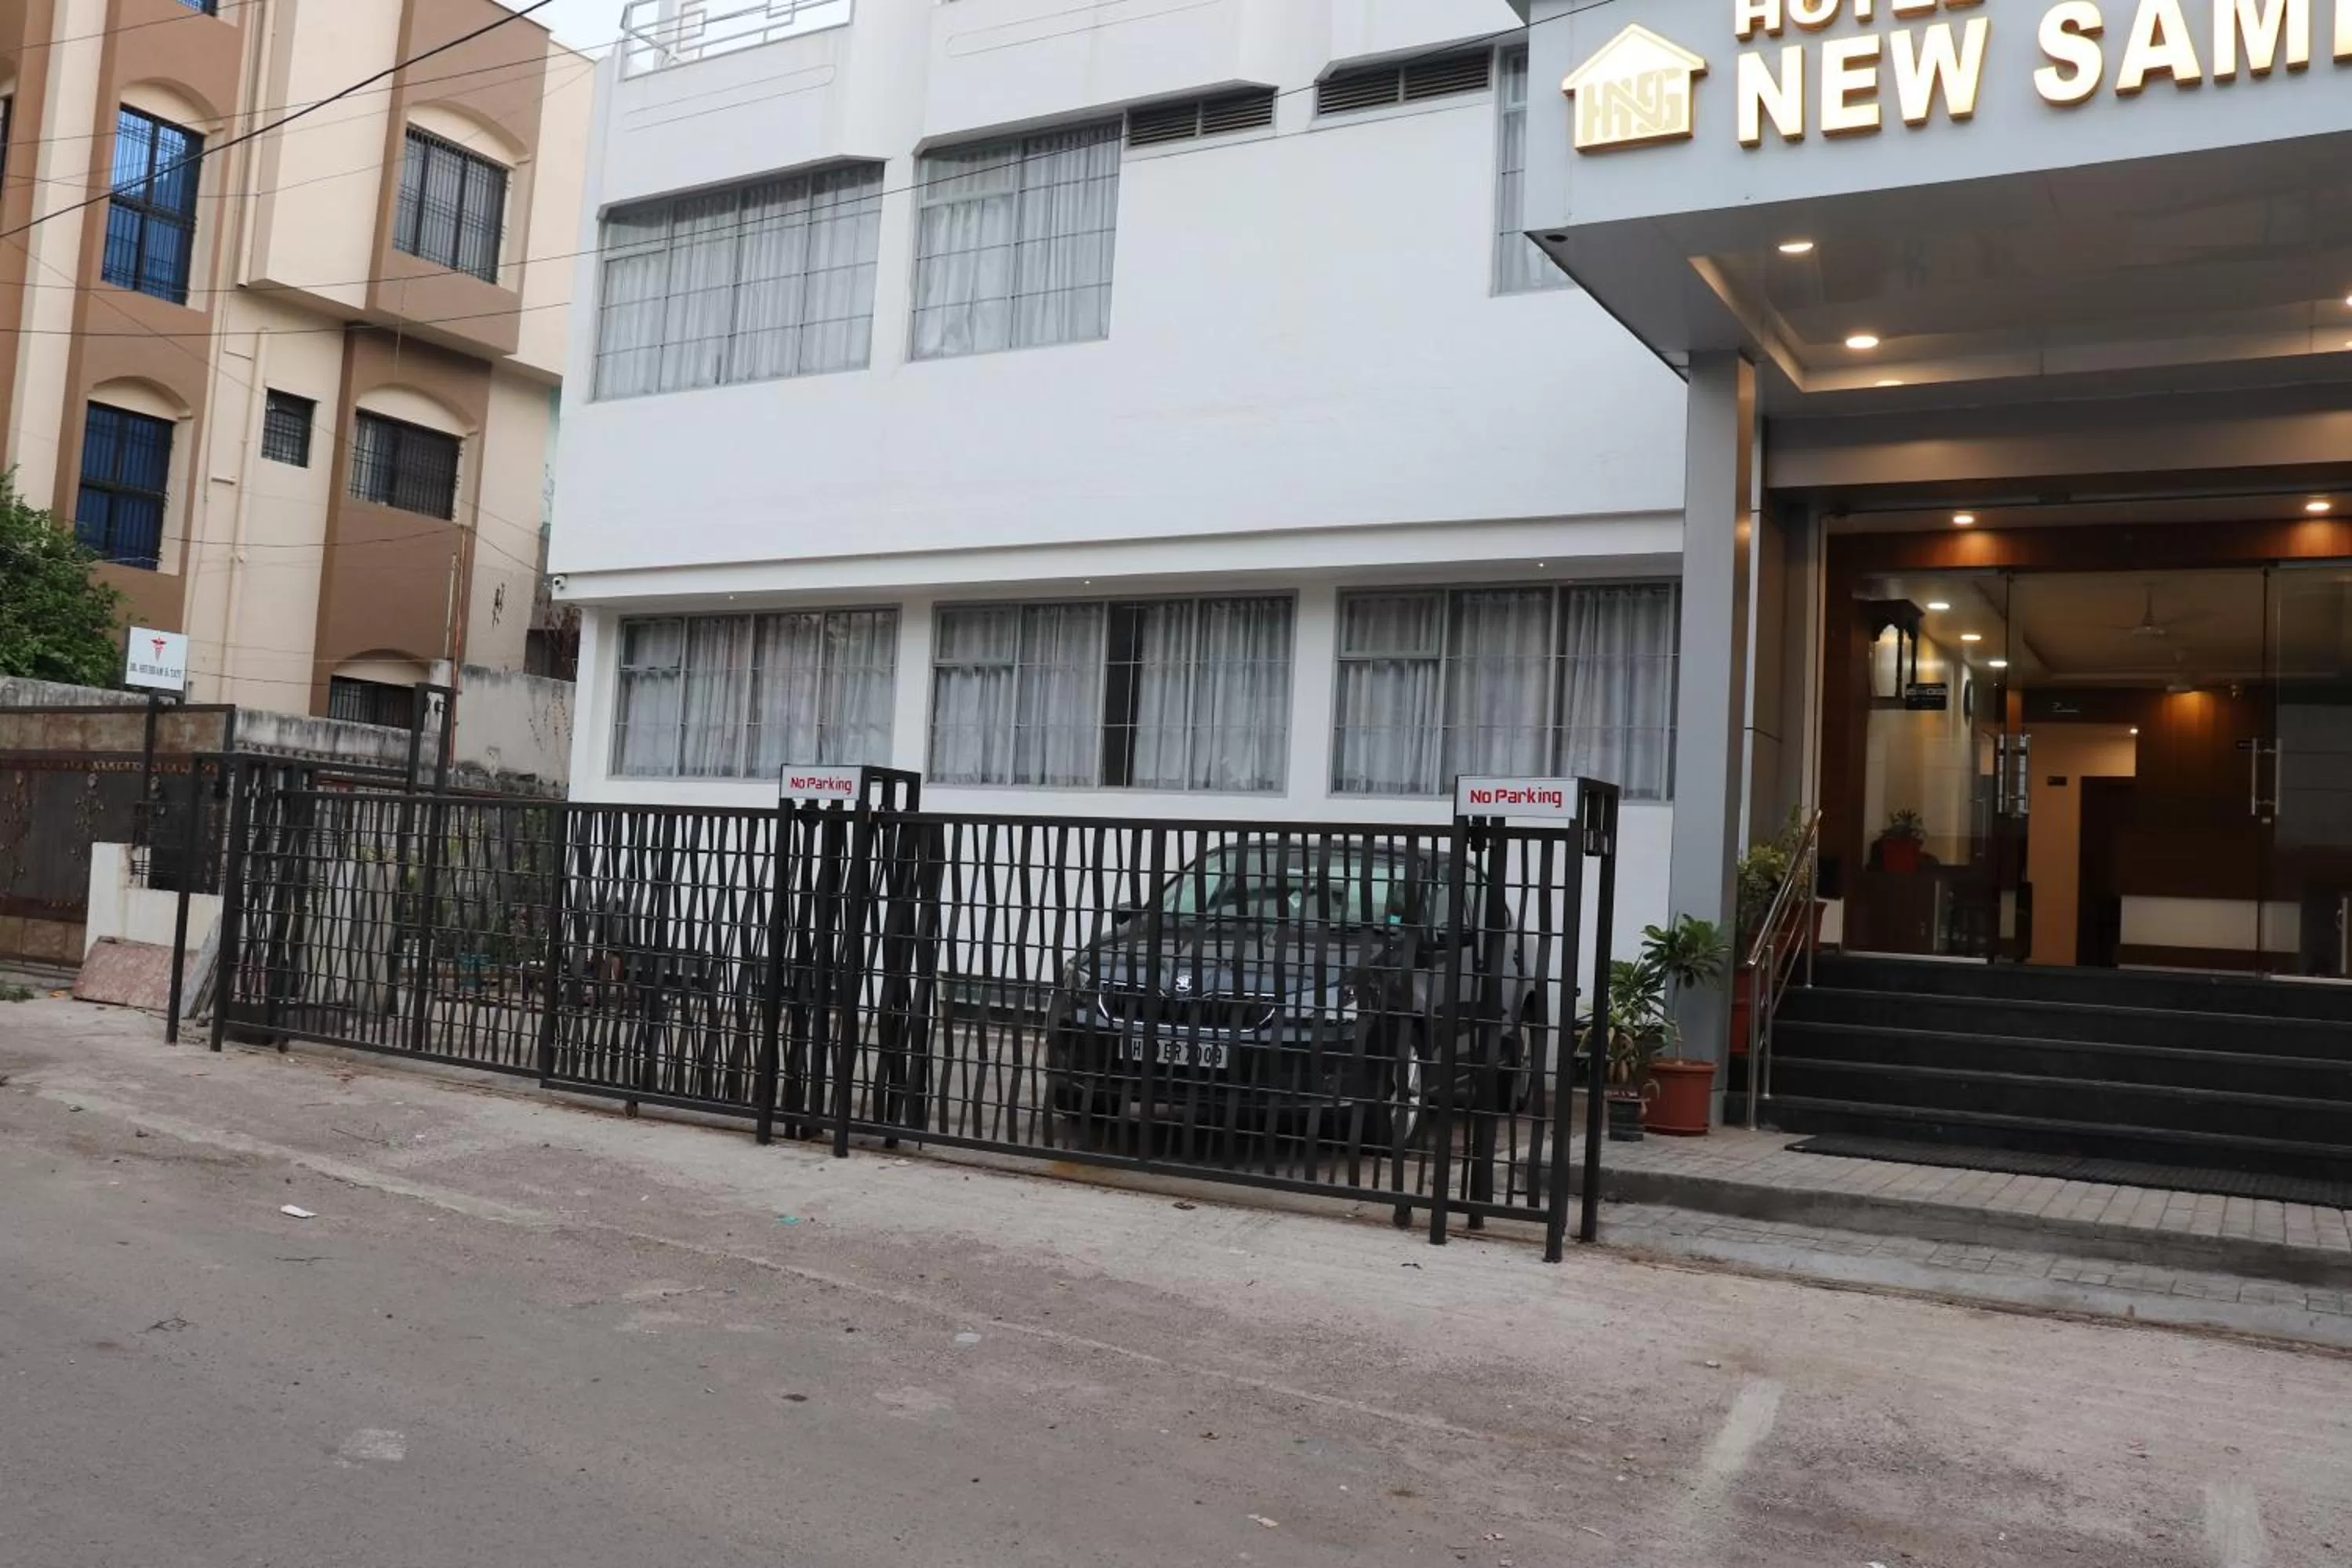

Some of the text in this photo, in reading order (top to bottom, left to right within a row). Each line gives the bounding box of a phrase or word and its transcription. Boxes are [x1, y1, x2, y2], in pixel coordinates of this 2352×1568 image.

[1737, 0, 2352, 147] NEW SAM
[790, 775, 852, 795] No Parking
[1470, 787, 1562, 808] No Parking
